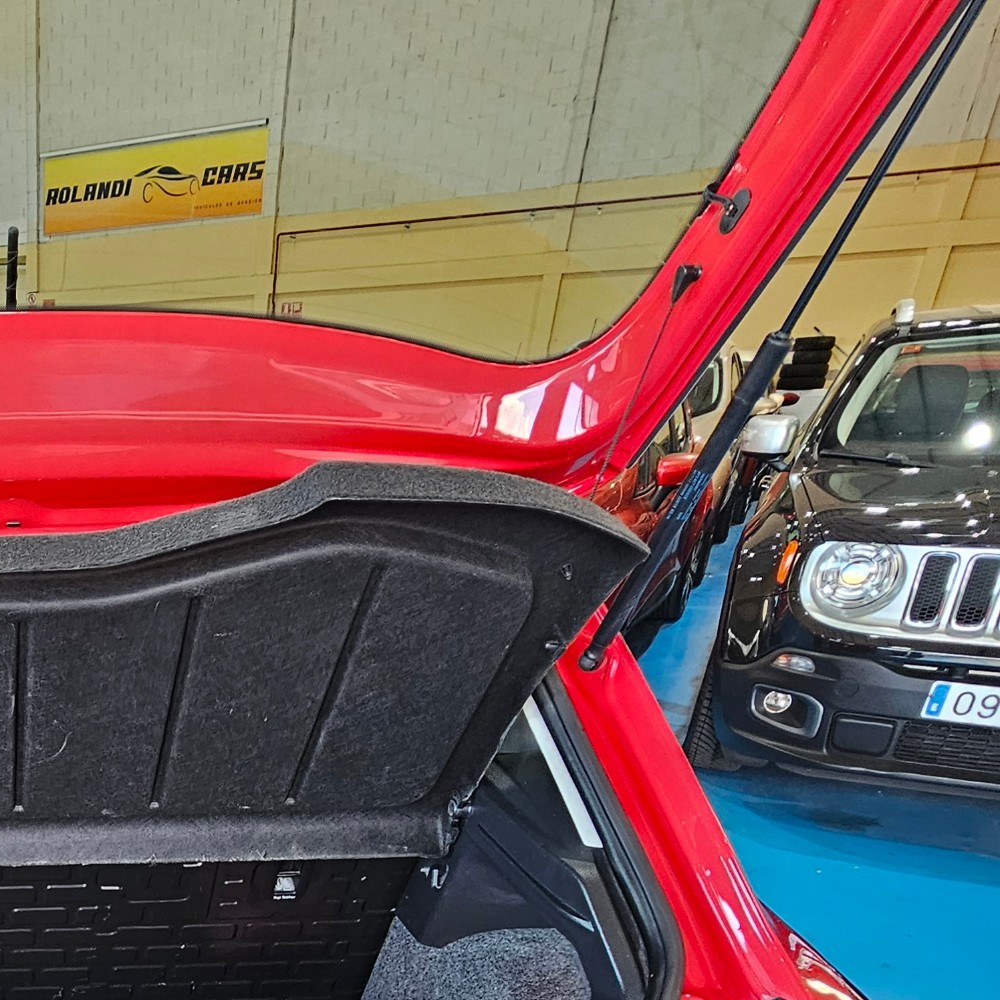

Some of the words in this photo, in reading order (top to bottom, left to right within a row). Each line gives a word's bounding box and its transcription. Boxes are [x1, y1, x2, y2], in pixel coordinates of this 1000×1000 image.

[46, 178, 132, 206] ROLANDI
[201, 160, 266, 187] CARS
[953, 691, 1000, 719] 09
